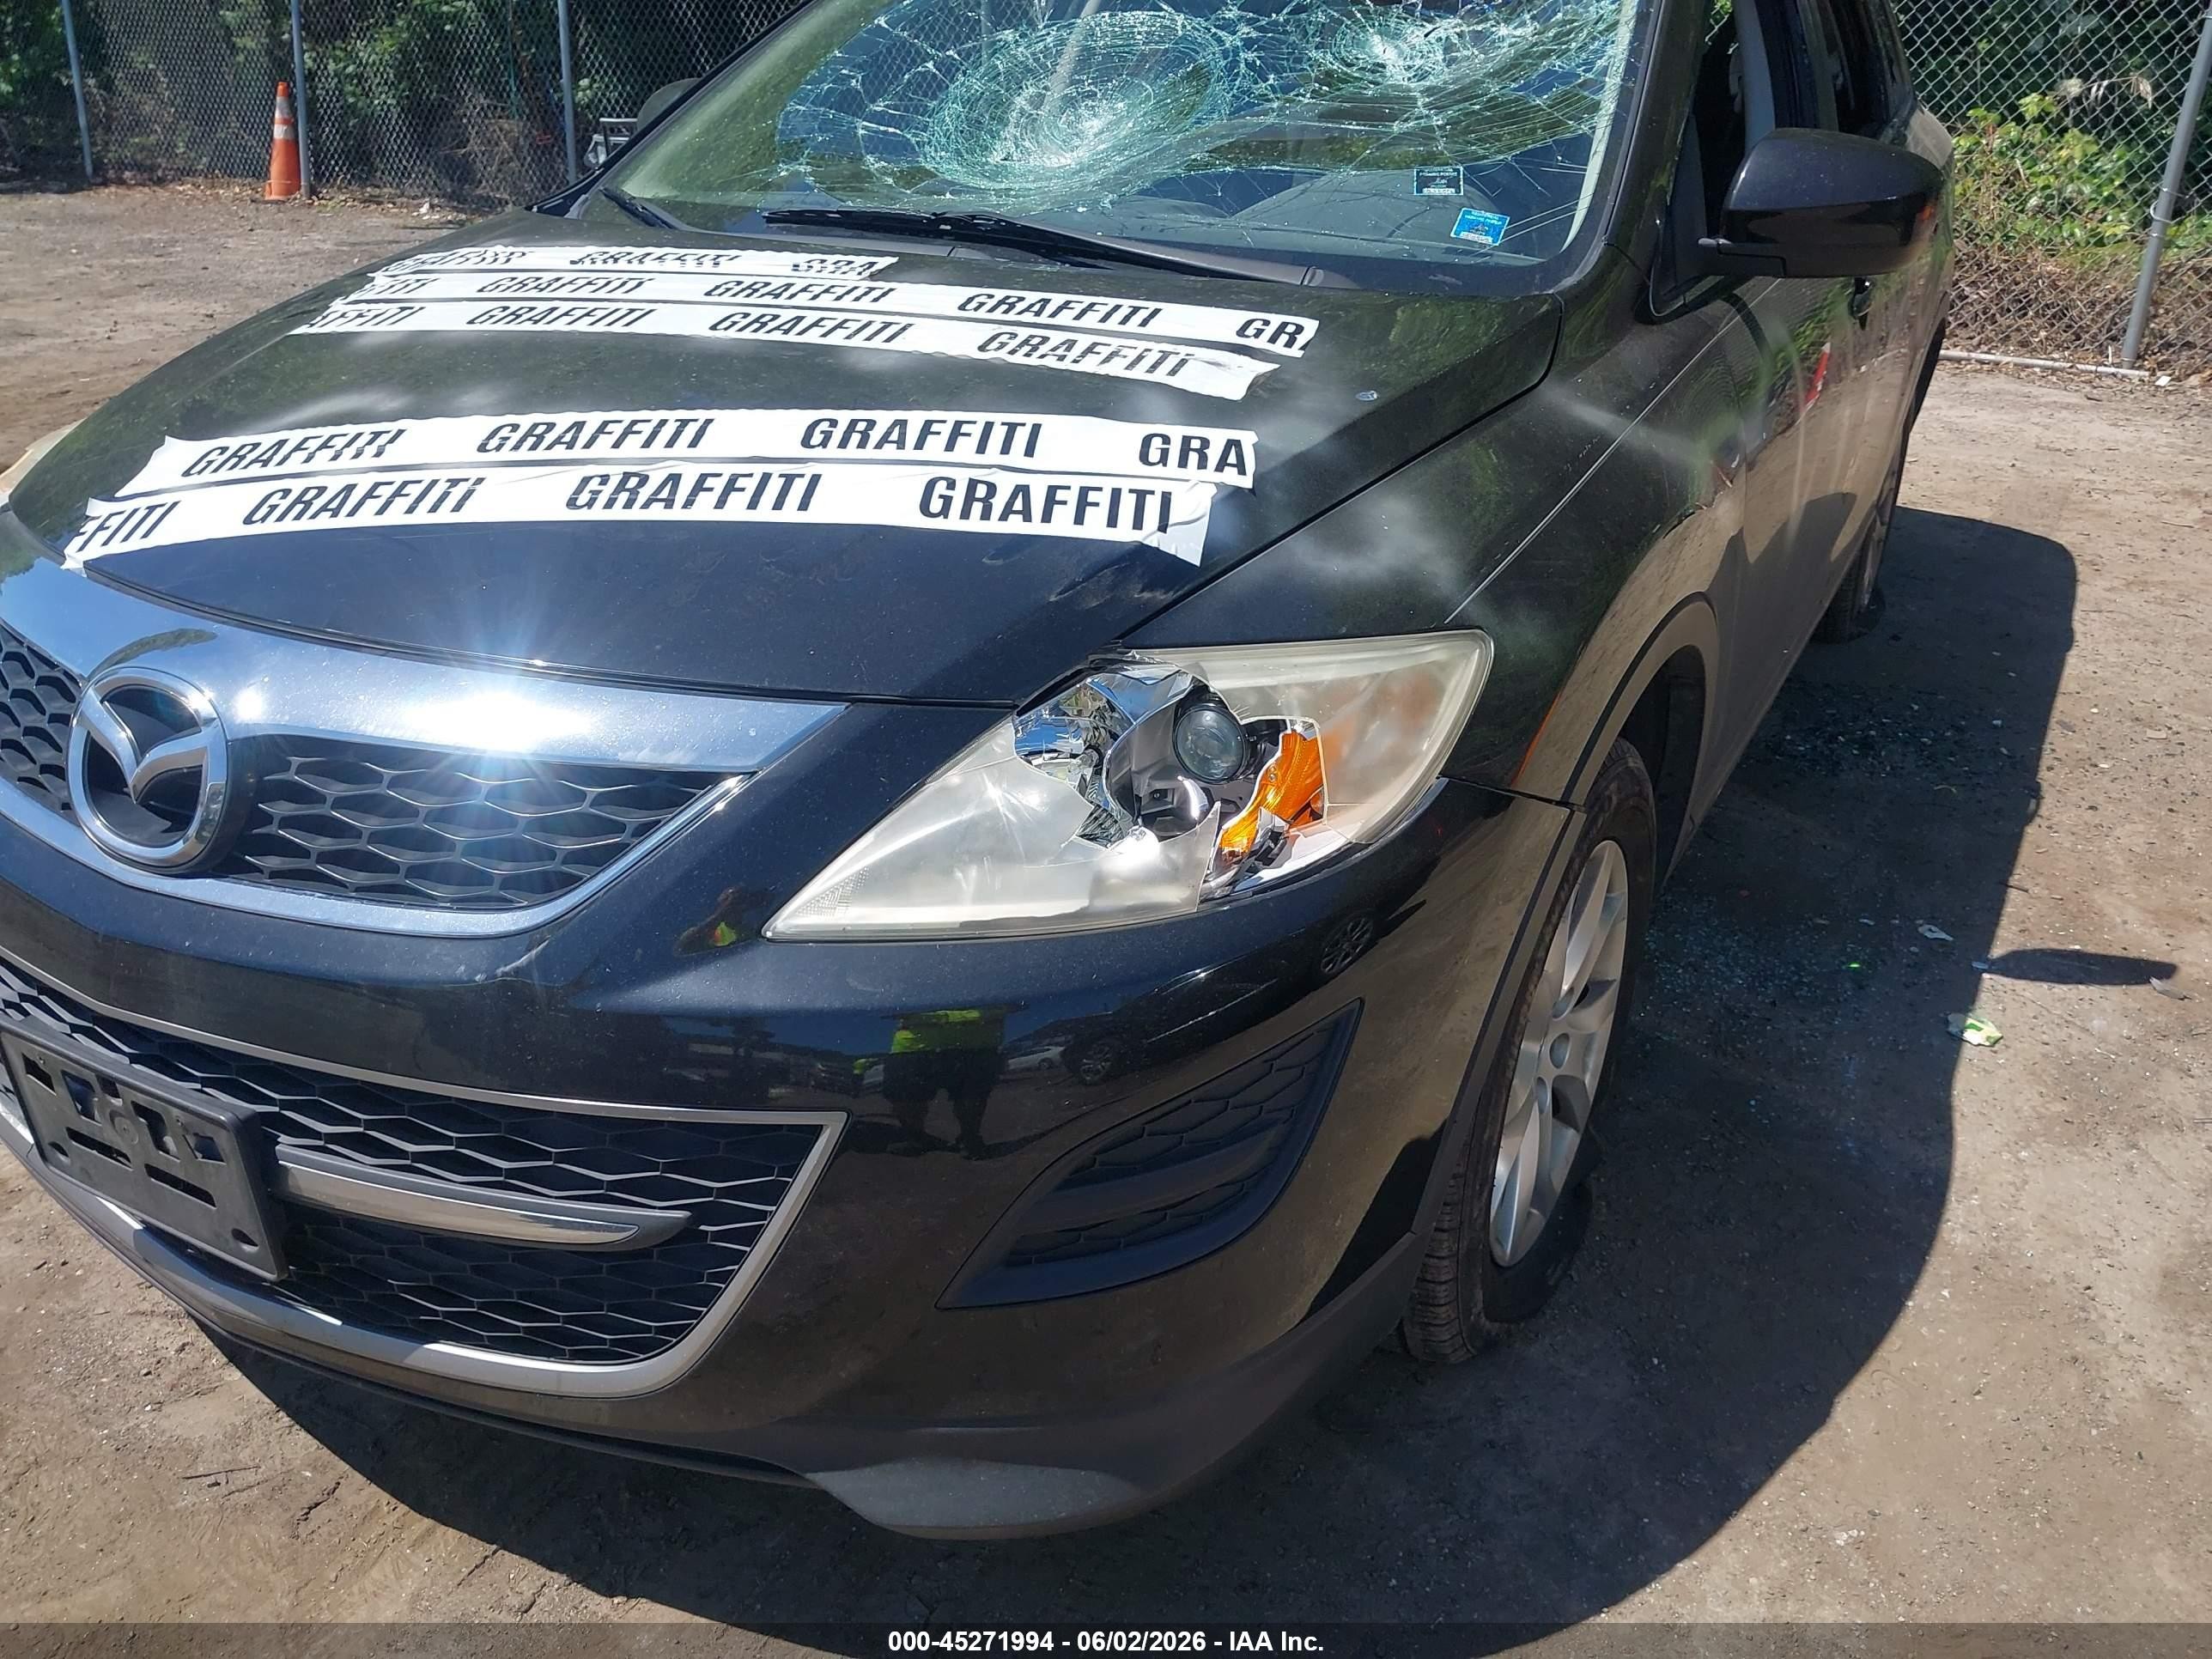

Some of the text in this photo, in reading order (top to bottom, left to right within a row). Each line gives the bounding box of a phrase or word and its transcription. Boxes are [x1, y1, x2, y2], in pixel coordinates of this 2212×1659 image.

[466, 307, 656, 326] GRAFFITI
[709, 313, 914, 343] GRAFFITI
[978, 332, 1188, 376] GRAFFITI
[477, 277, 653, 294] GRAFFITI
[704, 278, 896, 302] GRAFFITI
[957, 294, 1162, 327] GRAFFITI
[1236, 319, 1314, 350] GR
[182, 418, 1246, 477] GRAFFITI GRAFFITI GRAFFITI GRA
[243, 478, 485, 525] GRAFFITI
[566, 471, 822, 511] GRAFFITI
[920, 477, 1171, 533] GRAFFITI
